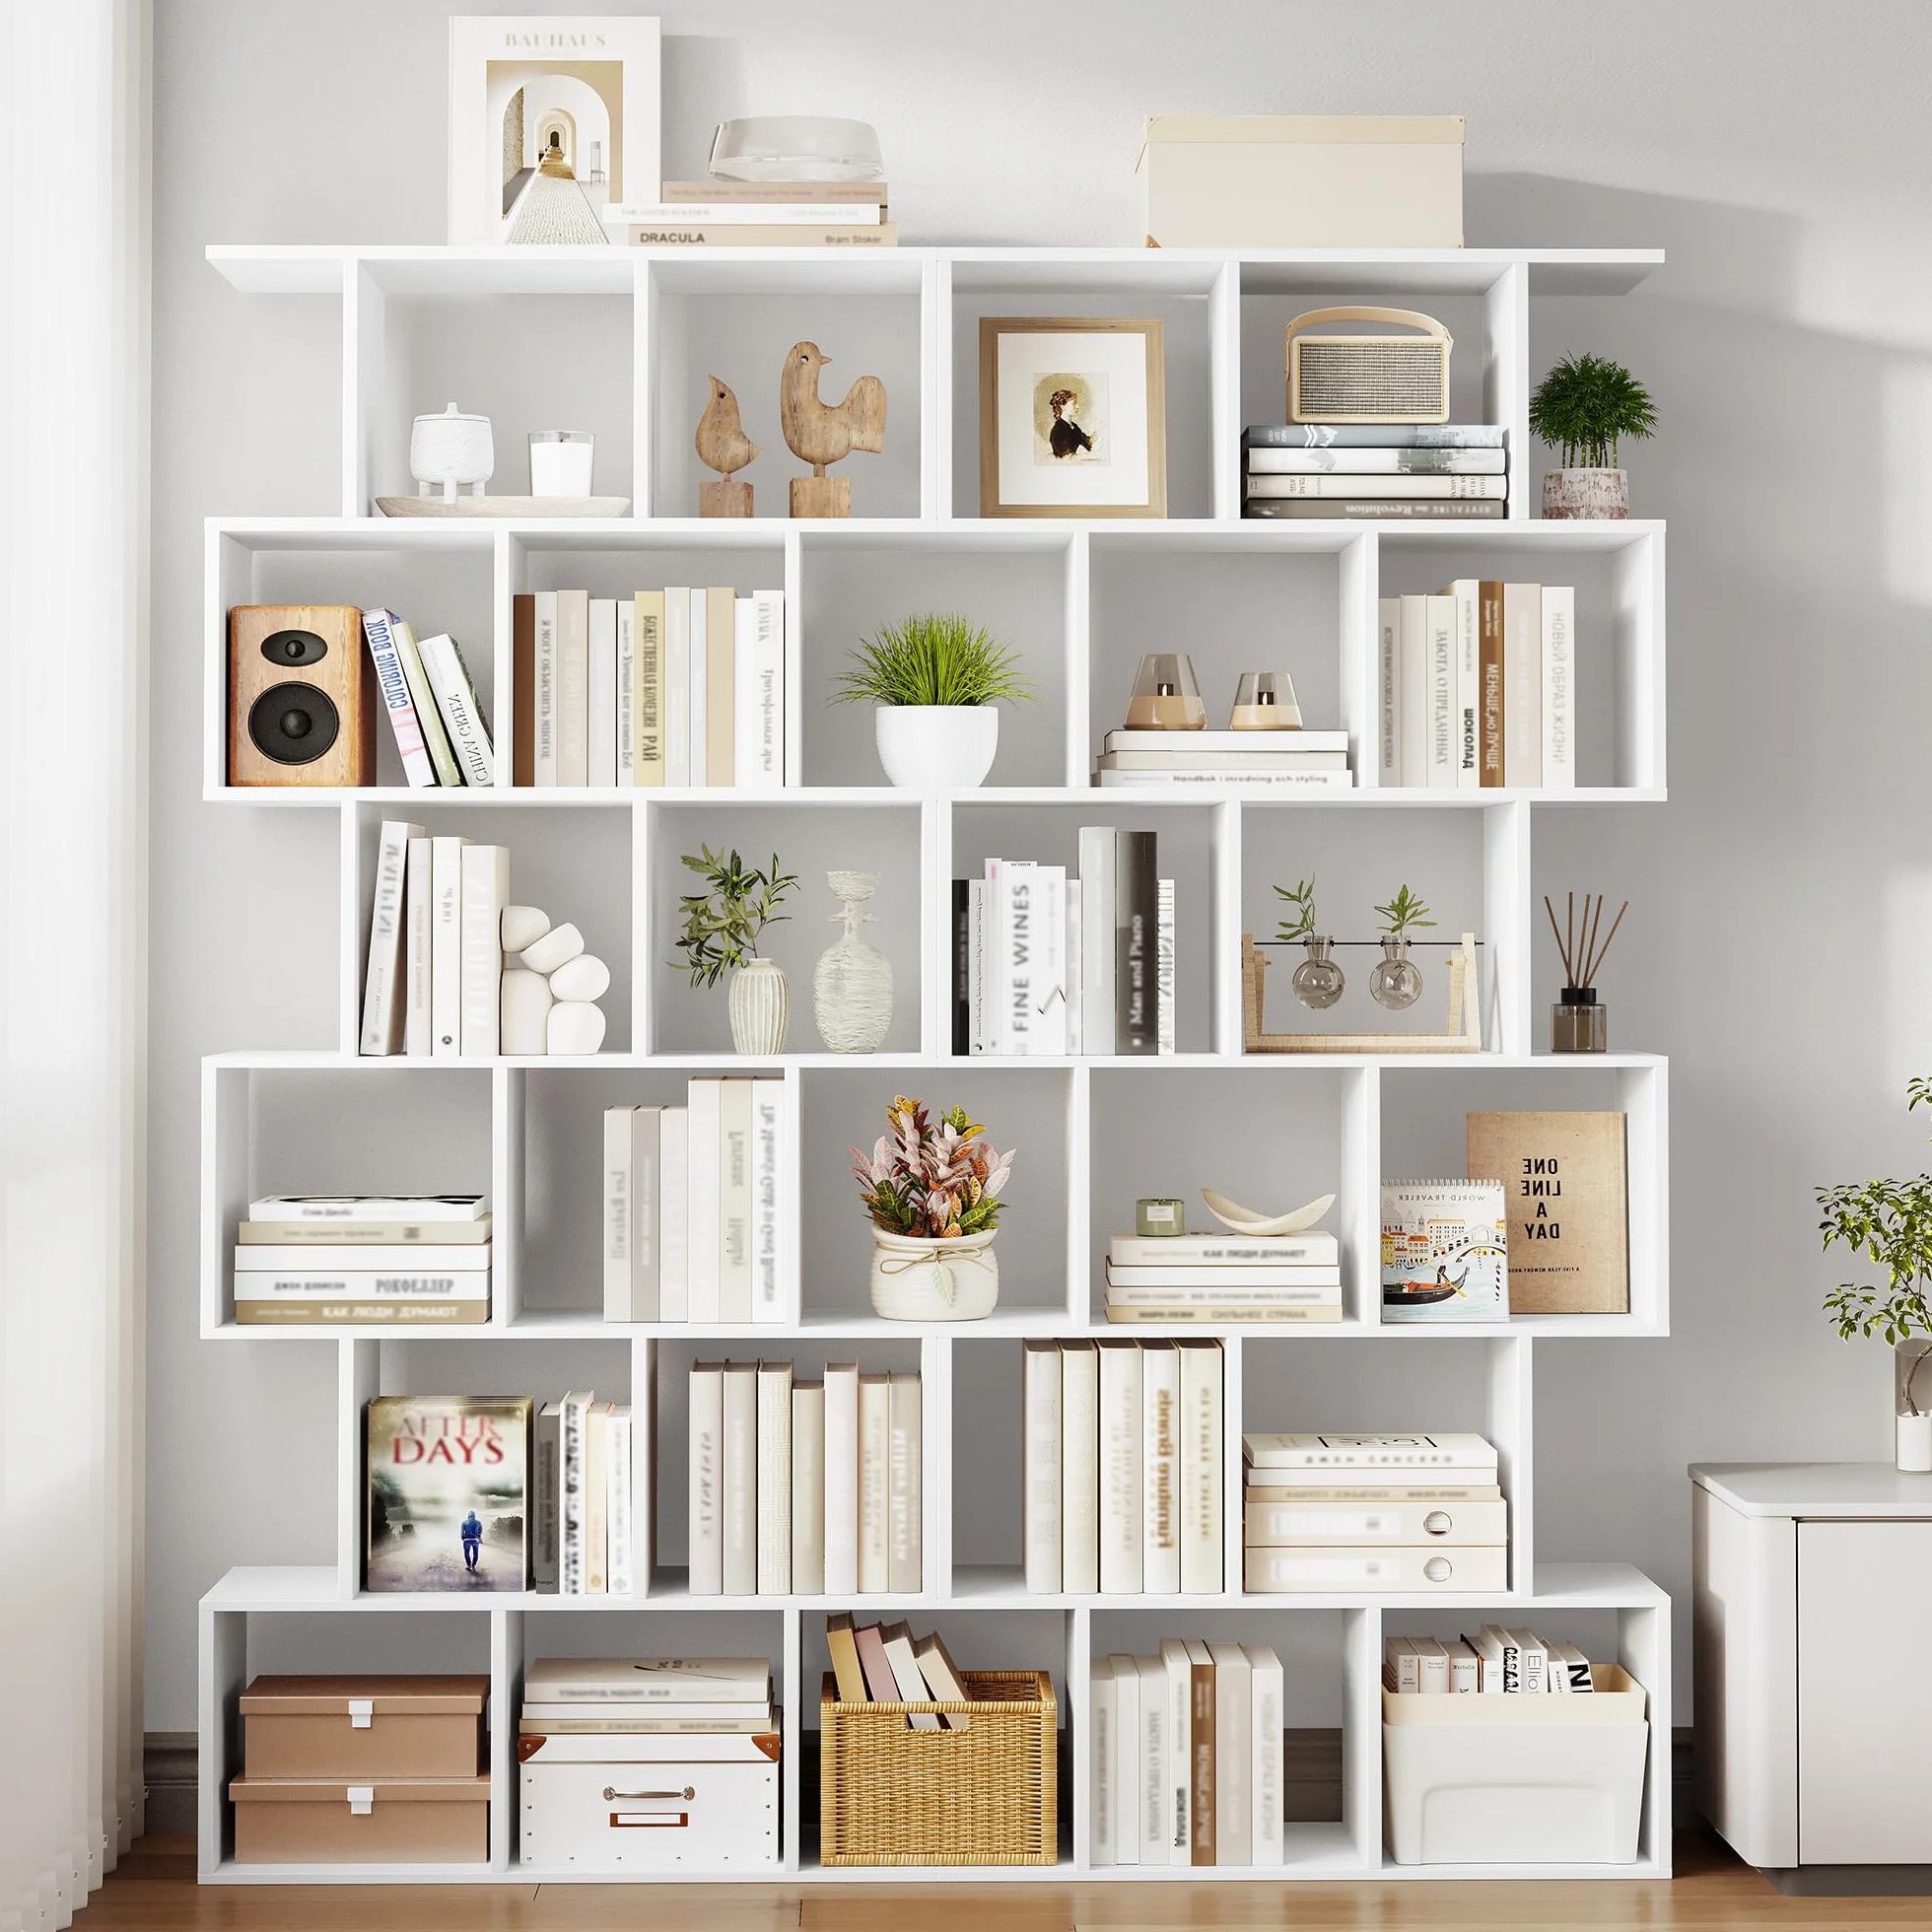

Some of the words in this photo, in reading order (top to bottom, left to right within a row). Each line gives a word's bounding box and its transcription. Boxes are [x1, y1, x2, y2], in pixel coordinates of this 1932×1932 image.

[505, 34, 607, 48] BAUHAUS
[640, 232, 706, 244] DRACULA
[825, 235, 850, 244] Bram
[852, 235, 882, 244] Stoker
[1346, 503, 1412, 516] Revolution
[643, 615, 657, 684] БОЖЕСТВЕННАЯ
[1435, 628, 1447, 674] ЗАБОТА
[1552, 612, 1567, 662] НОВЫЙ
[1435, 677, 1447, 687] О
[1552, 666, 1565, 709] ОБРАЗ
[643, 686, 657, 728] КОМЕДИЯ
[1434, 690, 1447, 765] ПРЕДАННЫХ
[1462, 708, 1475, 769] ШОКОЛАД
[1552, 714, 1565, 764] ЖИЗНИ
[643, 734, 661, 762] РАЙ
[1485, 728, 1499, 770] ЛУЧШЕ
[1295, 775, 1328, 785] styling
[1012, 884, 1030, 967] WINES
[1130, 915, 1143, 956] Piano
[1130, 958, 1143, 990] and
[1012, 978, 1030, 1032] FINE
[1130, 993, 1143, 1026] Man
[1202, 1249, 1223, 1258] КАК
[1226, 1249, 1259, 1258] ЛЮДИ
[1260, 1249, 1306, 1259] ДУМАЮТ
[376, 1278, 453, 1293] РОКФЕЛЛЕР
[321, 1306, 347, 1318] КАК
[352, 1306, 393, 1318] ЛЮДИ
[398, 1306, 458, 1319] ДУМАЮТ
[399, 1414, 504, 1441] AFTER
[392, 1436, 505, 1466] DAYS
